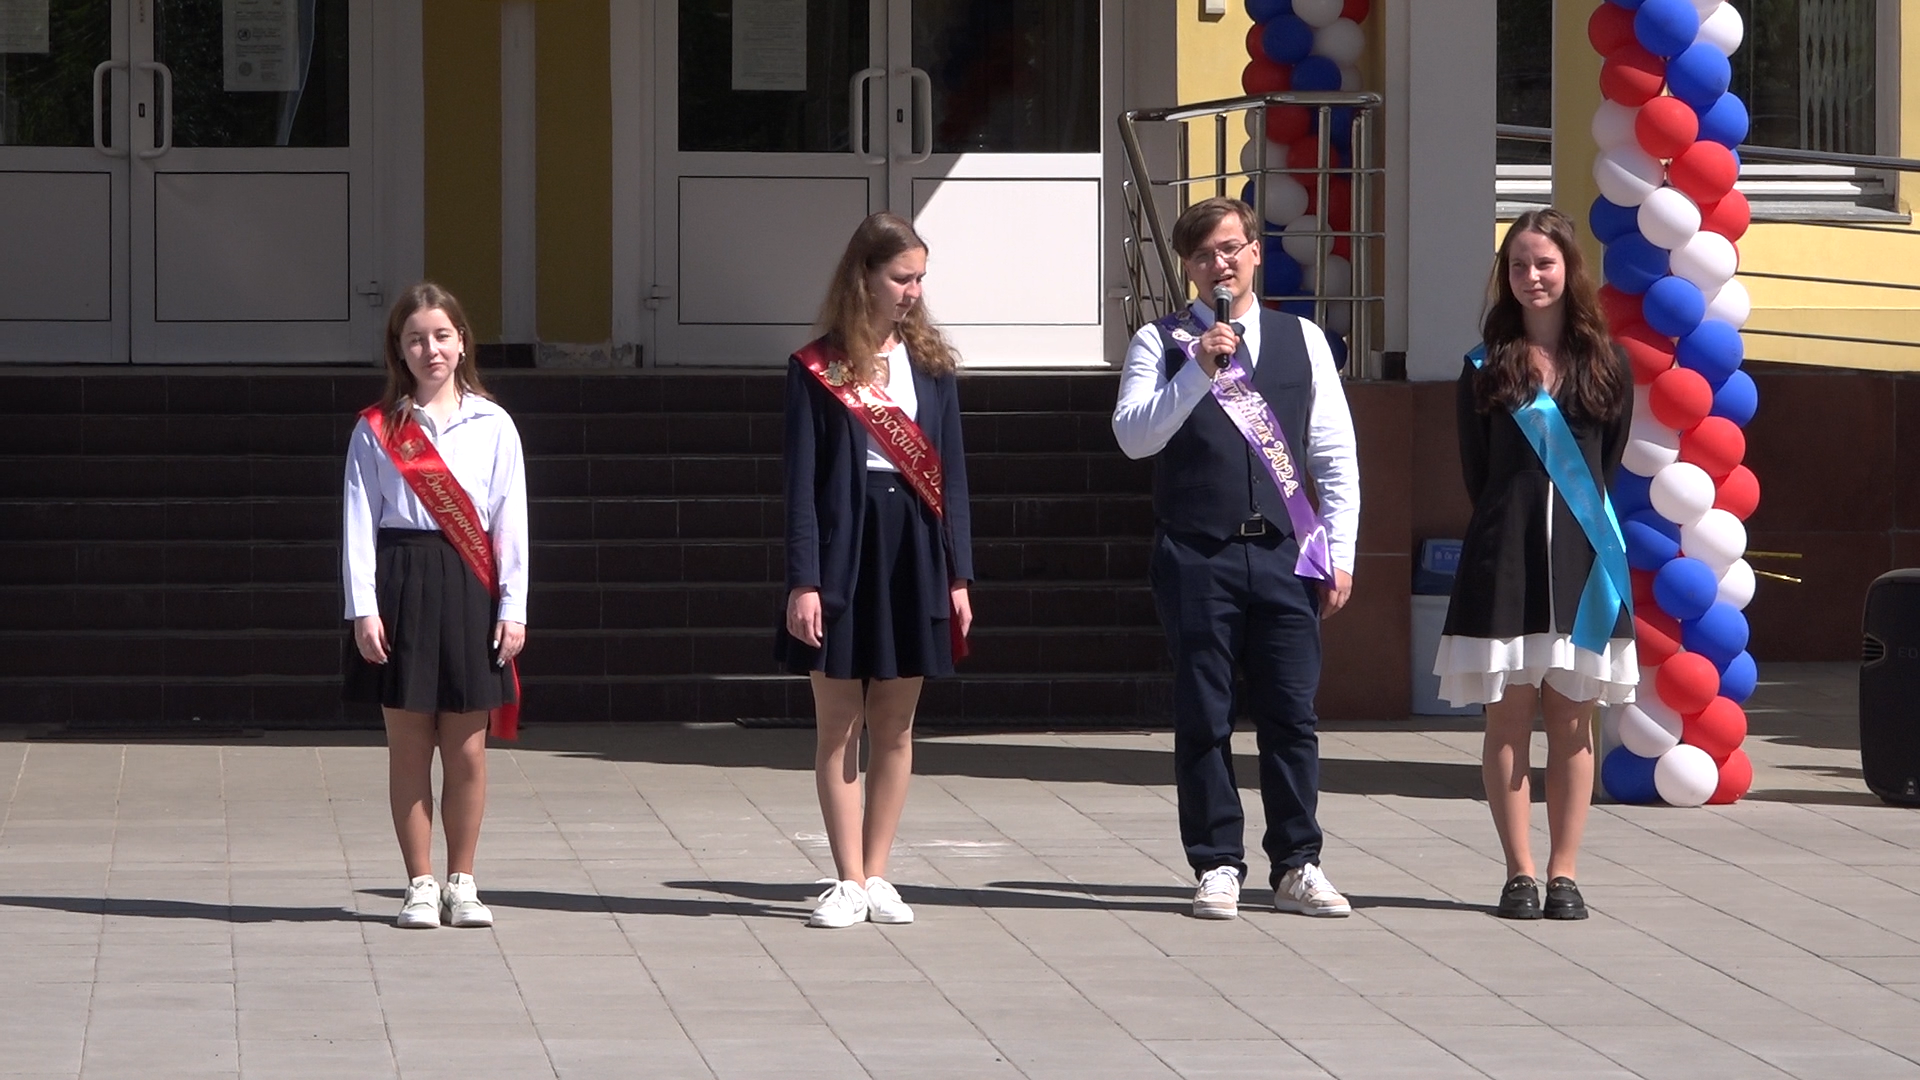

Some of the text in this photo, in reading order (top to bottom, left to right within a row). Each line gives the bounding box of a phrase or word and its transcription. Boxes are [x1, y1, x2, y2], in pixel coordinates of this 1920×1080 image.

[852, 381, 926, 470] пускник
[923, 465, 942, 495] 202
[1262, 439, 1299, 498] 2024
[419, 467, 488, 556] Выпускница
